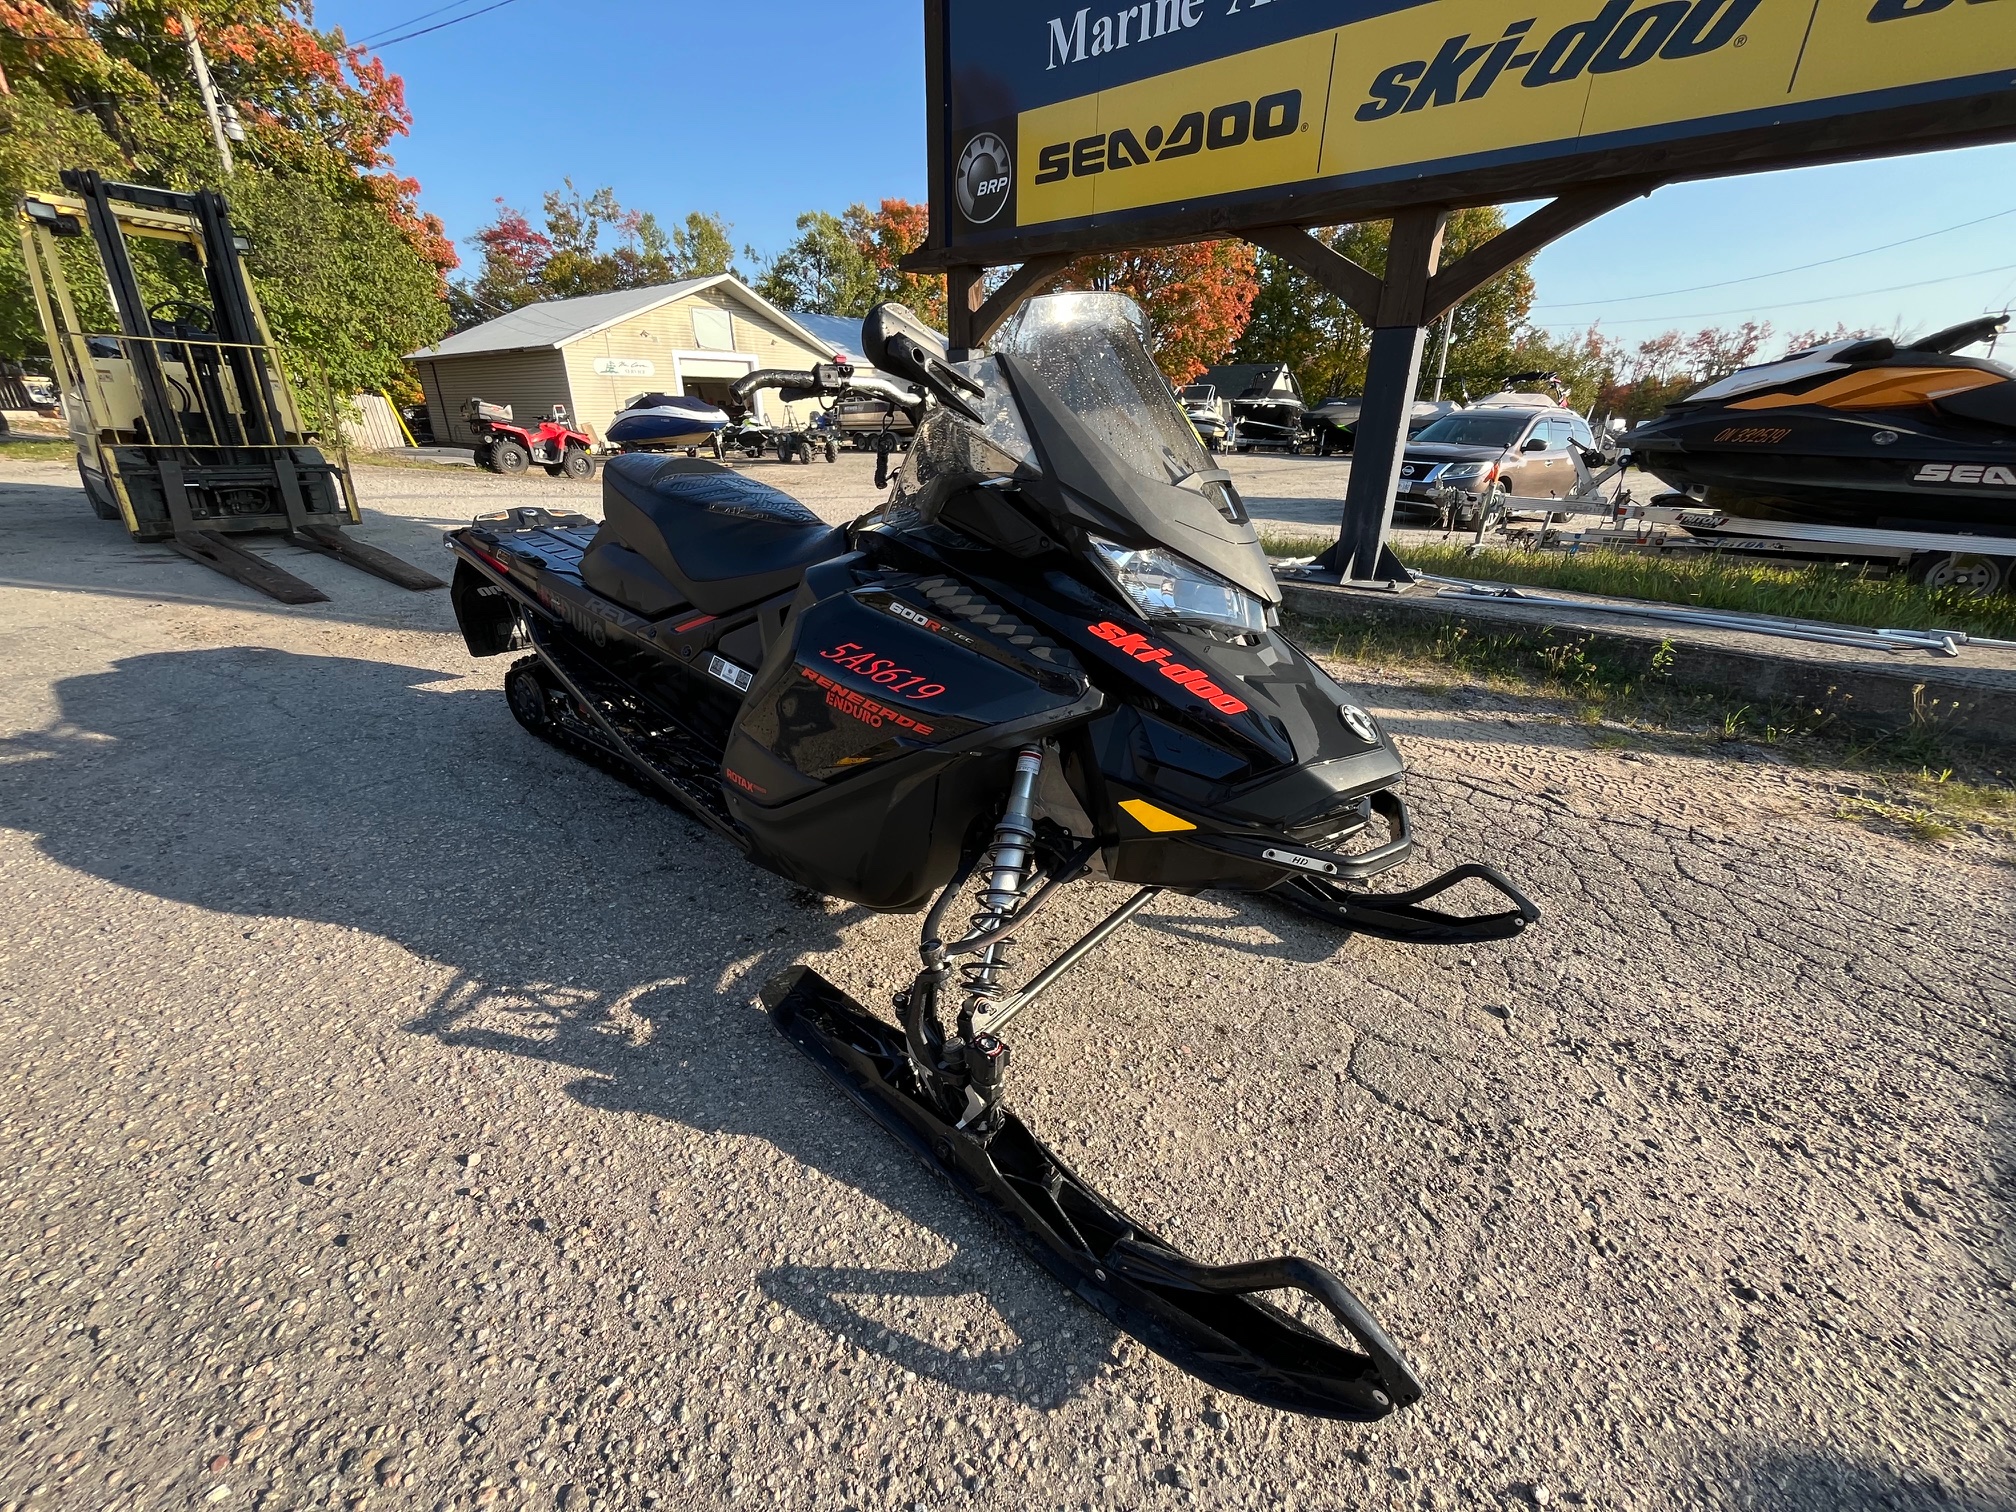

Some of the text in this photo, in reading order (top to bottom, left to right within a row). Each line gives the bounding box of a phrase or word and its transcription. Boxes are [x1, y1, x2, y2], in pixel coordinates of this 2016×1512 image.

[1046, 0, 1203, 70] Marine
[977, 176, 1009, 197] BRP
[1713, 427, 1793, 444] ON 3325191
[1681, 514, 1722, 526] TRITON
[584, 597, 638, 627] REV
[889, 602, 941, 633] 600R
[820, 642, 946, 699] 5AS619
[801, 667, 935, 736] RENEGADE
[825, 691, 883, 728] ENDURO
[726, 768, 754, 793] ROTAX
[1291, 856, 1309, 866] HD
